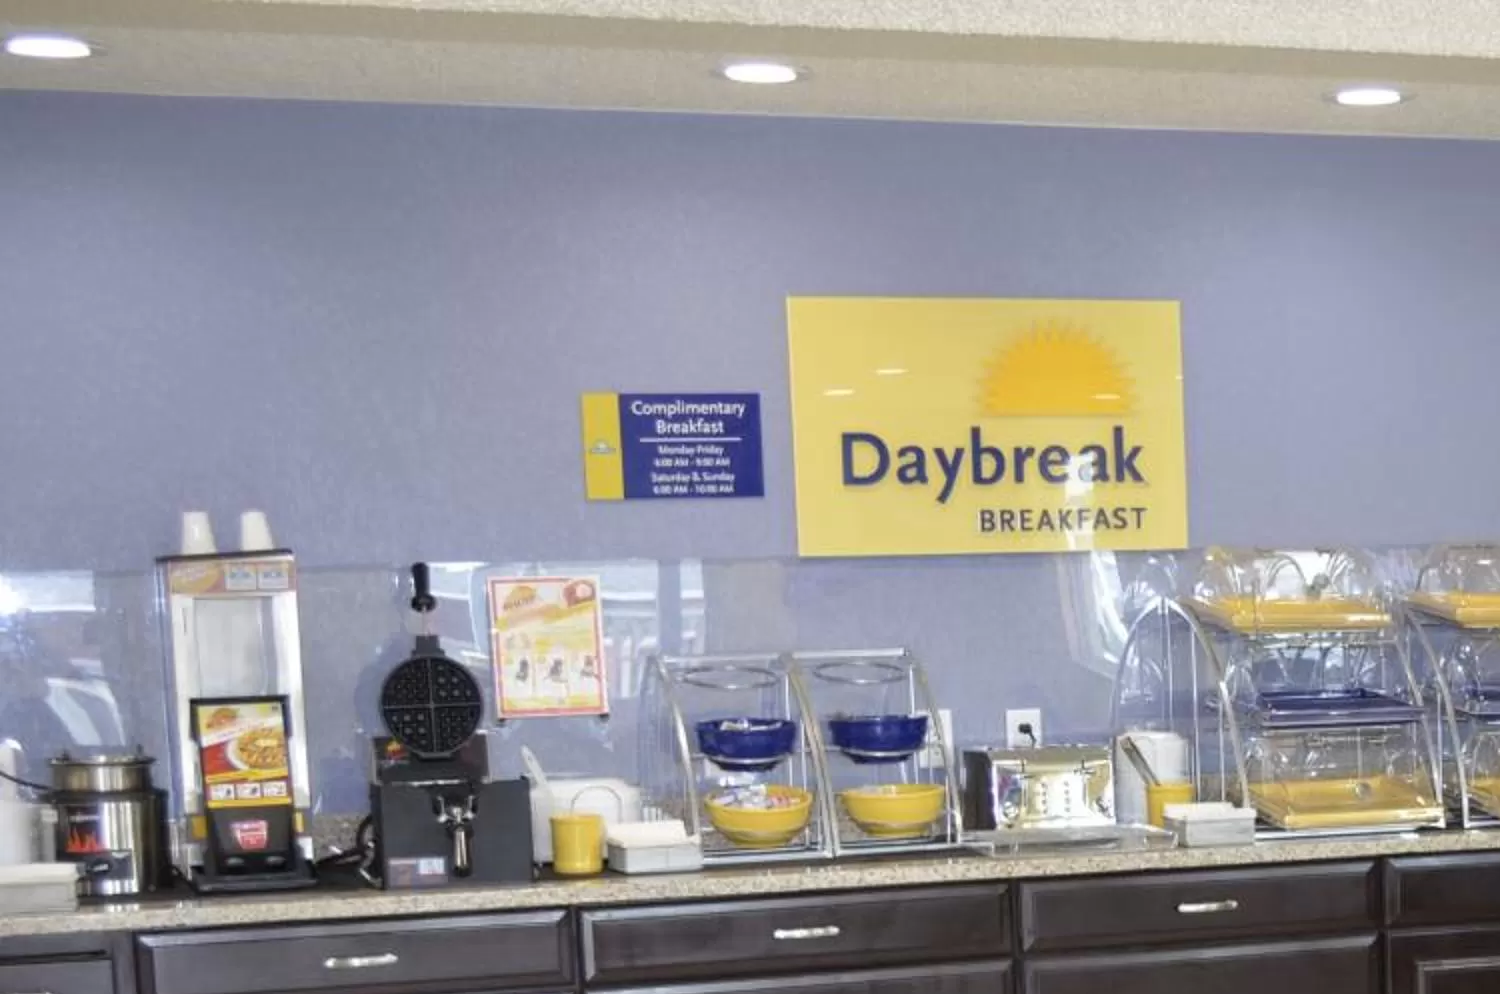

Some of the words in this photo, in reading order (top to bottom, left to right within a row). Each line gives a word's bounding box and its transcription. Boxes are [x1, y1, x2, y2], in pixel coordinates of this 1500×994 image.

[630, 399, 746, 419] Complimentary
[655, 417, 725, 435] Breakfast
[840, 425, 1147, 504] Daybreak
[979, 507, 1147, 533] BREAKFAST
